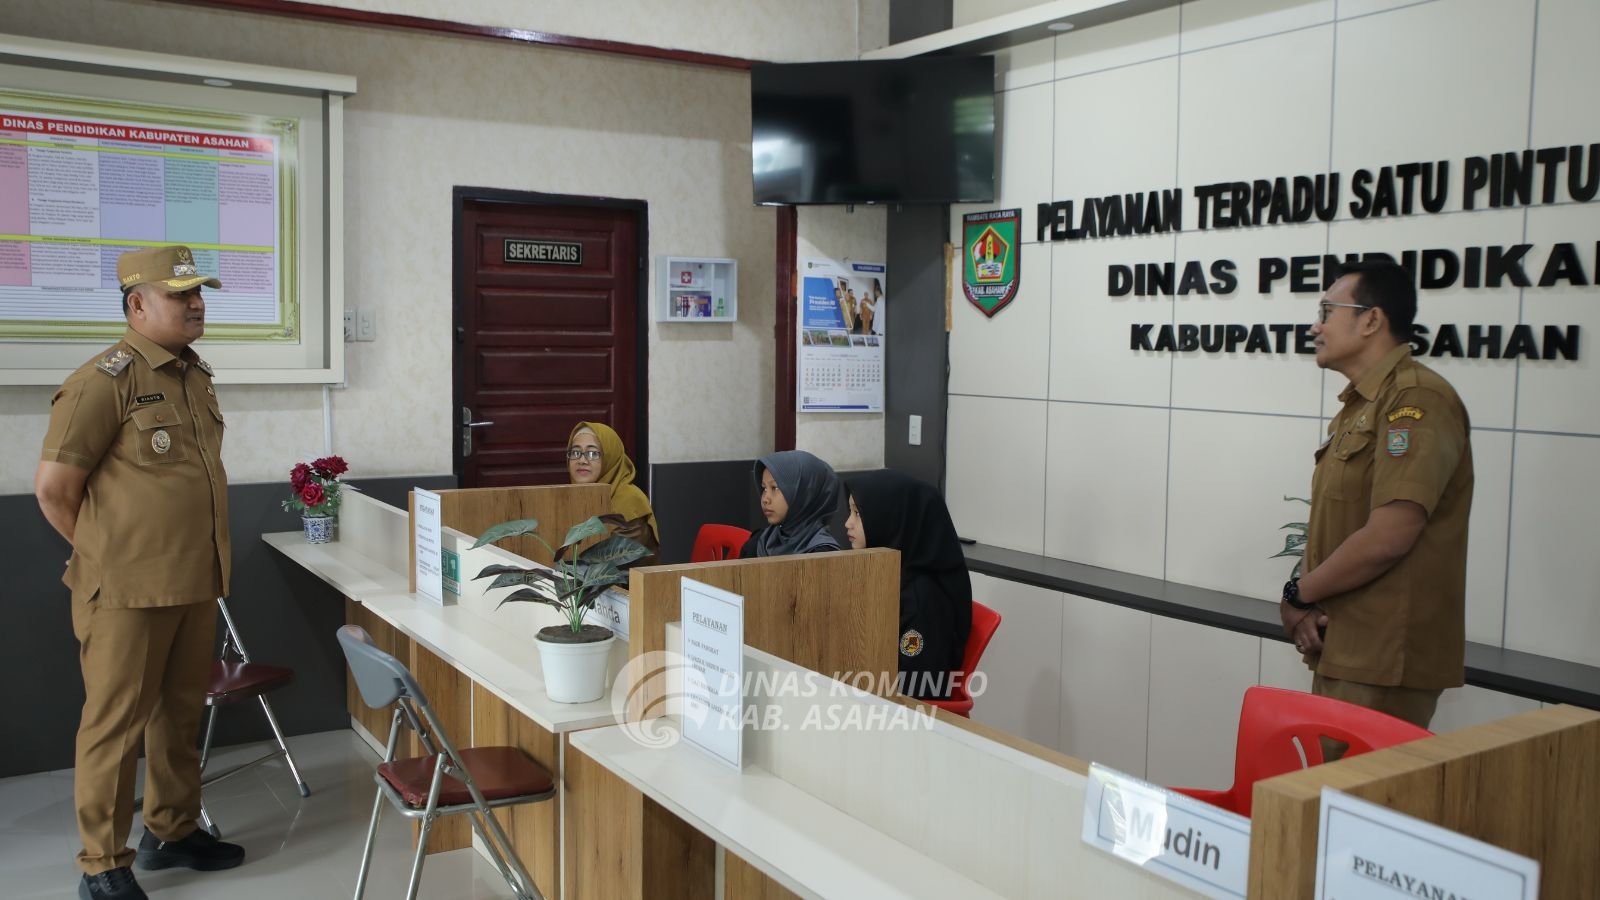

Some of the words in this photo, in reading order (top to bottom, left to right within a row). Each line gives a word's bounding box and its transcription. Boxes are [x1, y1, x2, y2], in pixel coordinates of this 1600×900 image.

[3, 118, 44, 130] DINAS
[47, 122, 126, 138] PENDIDIKAN
[129, 130, 199, 144] KABUPATEN
[203, 137, 249, 149] ASAHAN
[1036, 188, 1182, 242] PELAYANAN
[1194, 172, 1340, 230] TERPADU
[1350, 160, 1450, 219] SATU
[1463, 143, 1600, 211] PINTU
[509, 243, 577, 261] SEKRETARIS
[1107, 258, 1237, 297] DINAS
[1258, 241, 1600, 293] PENIDIKA
[1130, 323, 1316, 355] KABUPATE
[1409, 323, 1579, 360] SAHAN
[594, 600, 620, 624] anda
[692, 612, 728, 632] PELAYANAN
[1353, 855, 1475, 900] PELAYANA
